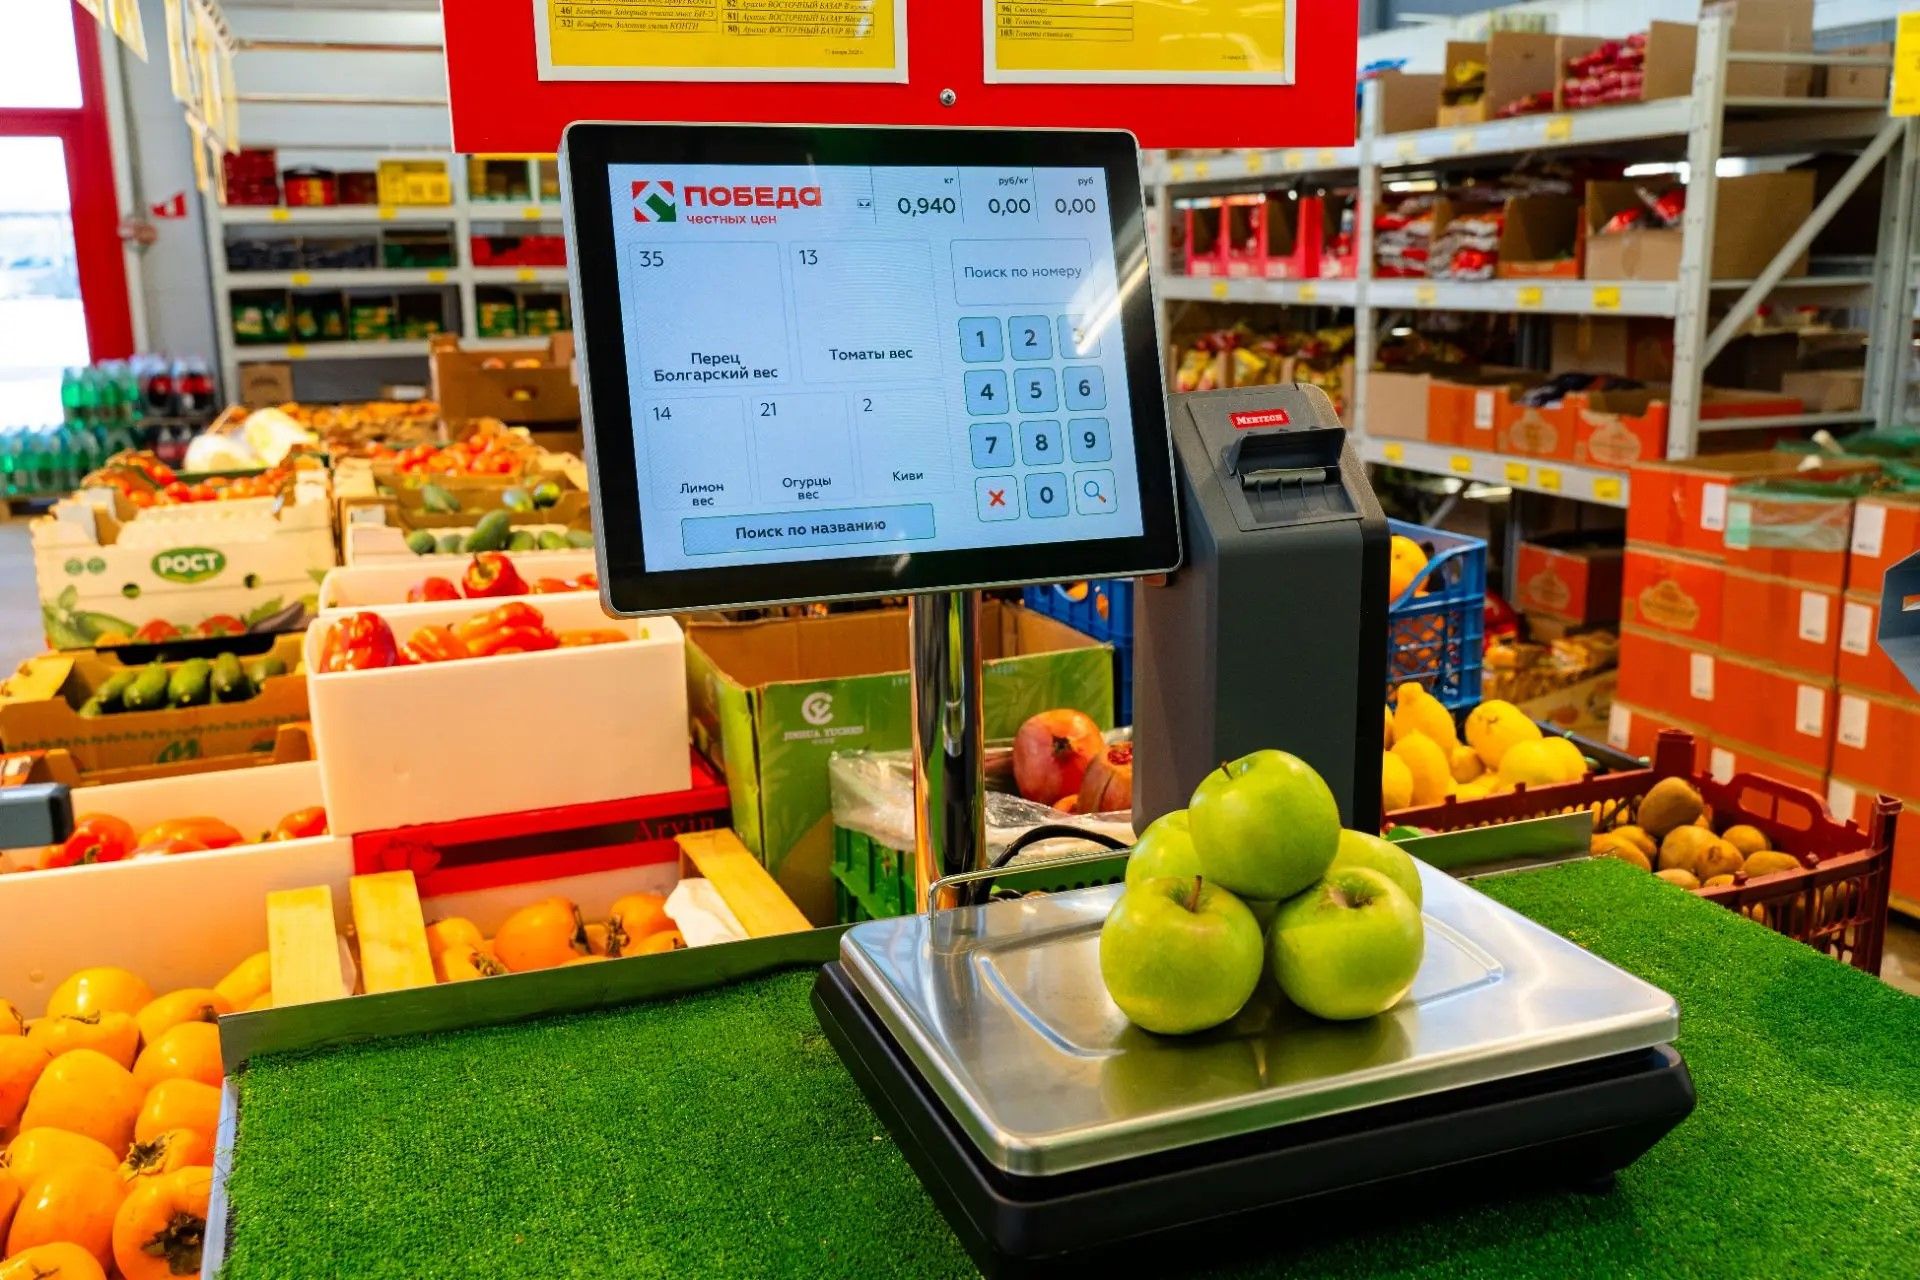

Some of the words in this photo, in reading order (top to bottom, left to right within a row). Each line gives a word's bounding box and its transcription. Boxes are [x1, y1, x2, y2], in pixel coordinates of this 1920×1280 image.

[560, 6, 571, 15] 46
[562, 20, 571, 28] 32
[944, 178, 954, 186] кг
[998, 176, 1029, 187] руб/кг
[1078, 177, 1094, 187] руб
[897, 198, 956, 217] 0,940
[988, 198, 1031, 216] 0,00
[1055, 198, 1097, 216] 0,00
[686, 214, 747, 225] честных
[751, 214, 778, 226] цен
[639, 250, 665, 267] 35
[798, 249, 818, 265] 13
[964, 266, 1008, 278] Поиск
[1012, 268, 1028, 278] по
[1033, 267, 1082, 279] номеру
[976, 330, 985, 347] 1
[1024, 328, 1038, 346] 2
[690, 352, 741, 366] Перец
[829, 348, 885, 361] Томаты
[889, 347, 914, 359] вес
[653, 365, 749, 382] Болгарский
[753, 367, 778, 380] вес
[980, 383, 994, 400] 4
[1030, 381, 1042, 399] 5
[1078, 379, 1091, 397] 6
[760, 402, 777, 417] 21
[863, 398, 873, 413] 2
[652, 406, 672, 421] 14
[985, 436, 997, 454] 7
[1035, 434, 1048, 451] 8
[1084, 431, 1096, 449] 9
[782, 475, 832, 490] Огурцы
[892, 470, 925, 483] Киви
[679, 482, 725, 495] Лимон
[797, 490, 820, 501] вес
[1039, 486, 1053, 504] 0
[692, 496, 715, 507] вес
[735, 524, 784, 541] Поиск
[788, 524, 807, 537] по
[810, 519, 887, 535] названию
[158, 552, 219, 575] РОСТ
